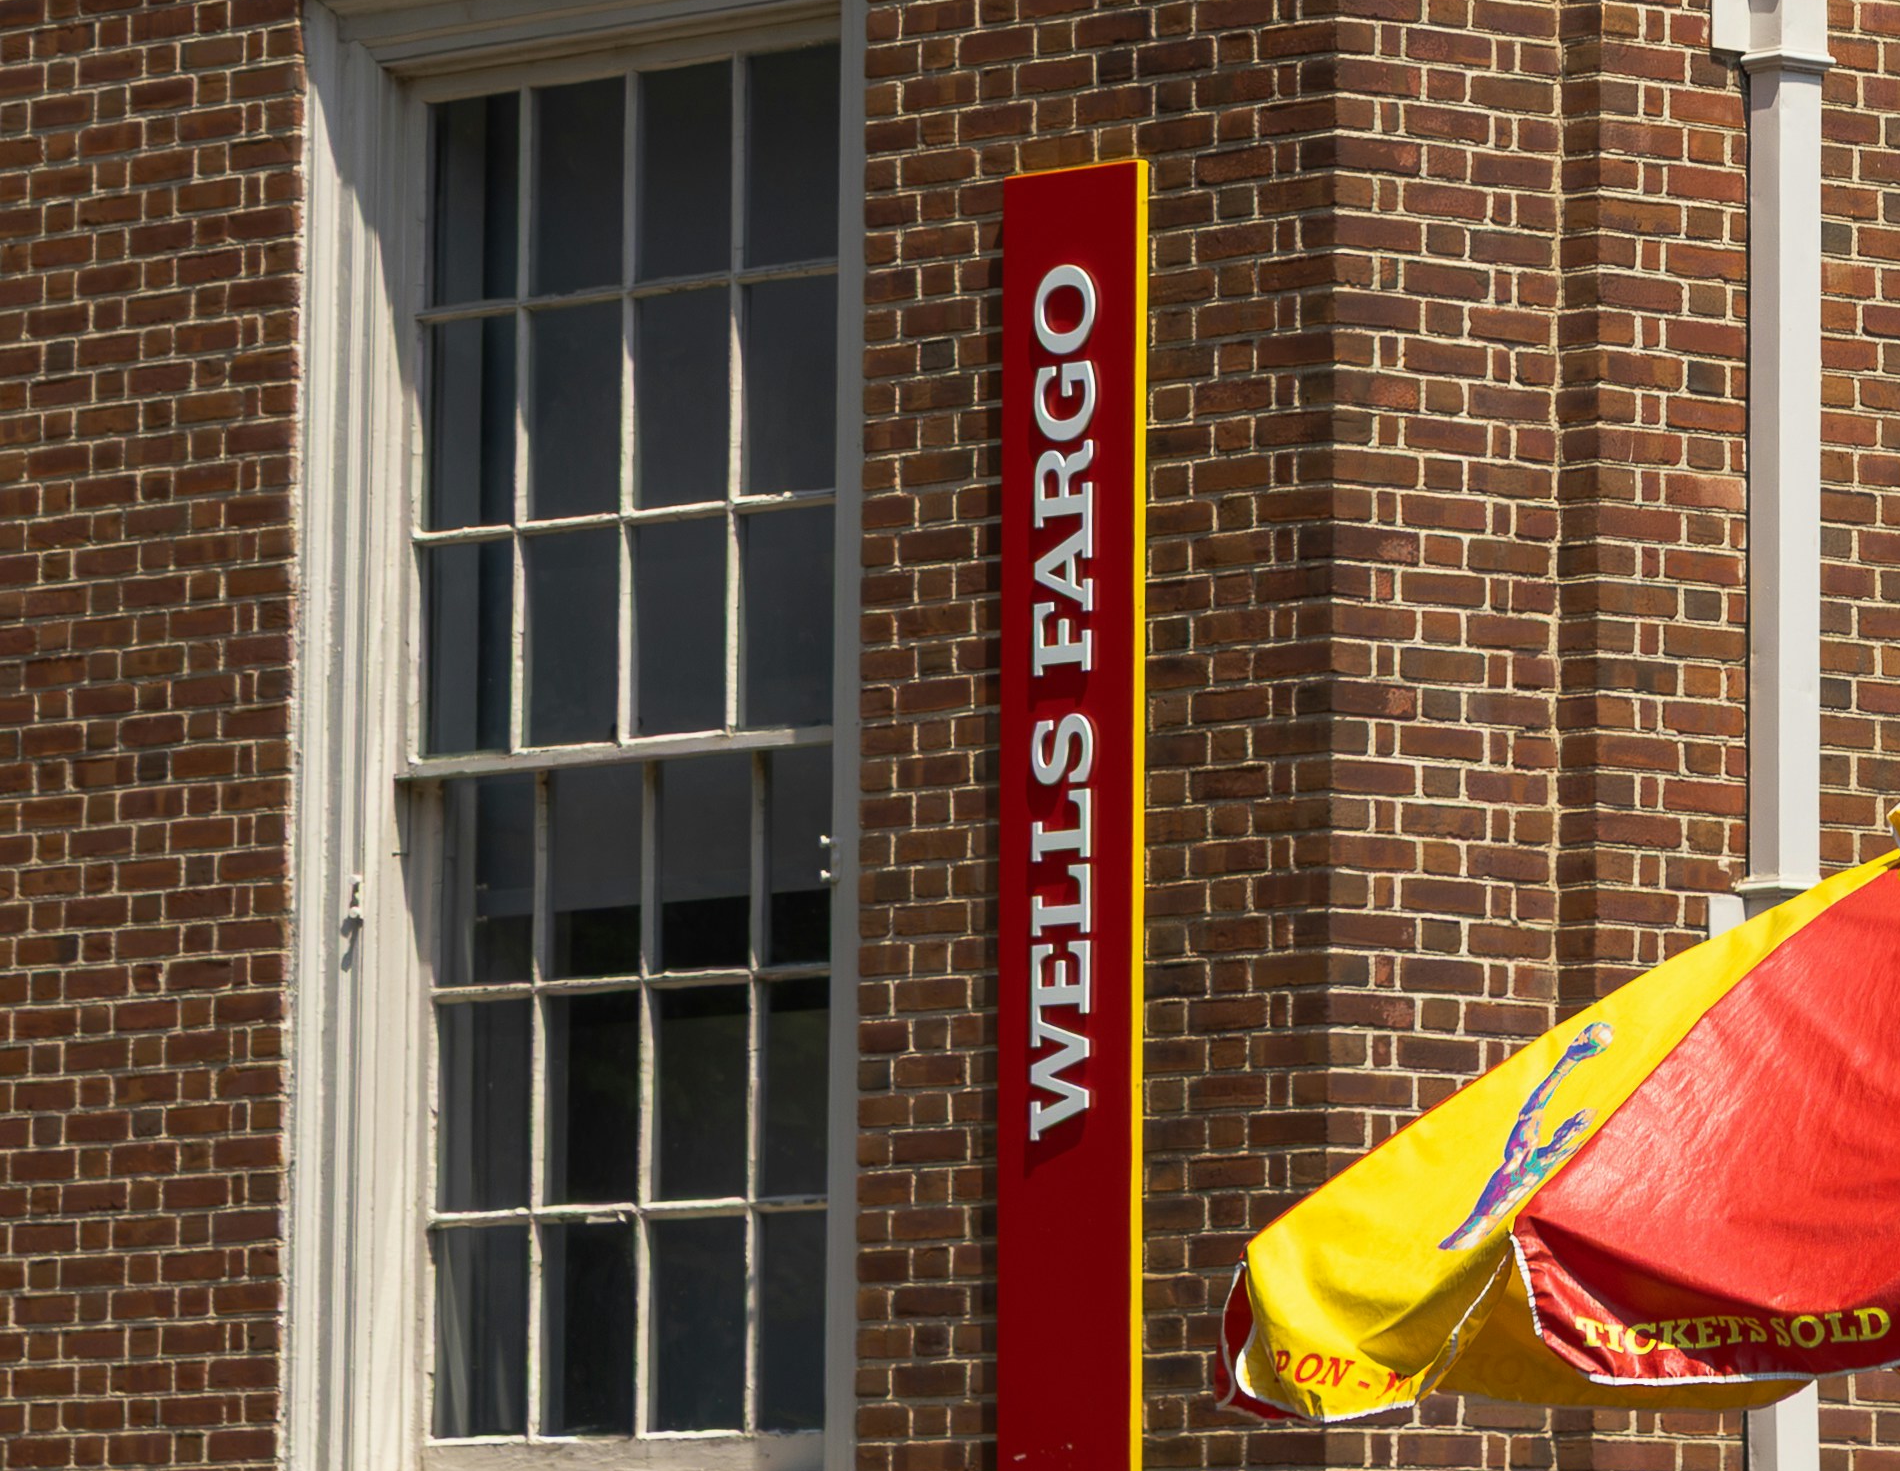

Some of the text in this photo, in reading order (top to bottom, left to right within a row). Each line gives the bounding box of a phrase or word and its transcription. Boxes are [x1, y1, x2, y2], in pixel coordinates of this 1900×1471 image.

[1028, 262, 1098, 1143] WELLS FARGO
[1574, 1315, 1770, 1356] TICKETS
[1773, 1305, 1892, 1349] SOLD
[1294, 1352, 1356, 1387] ON
